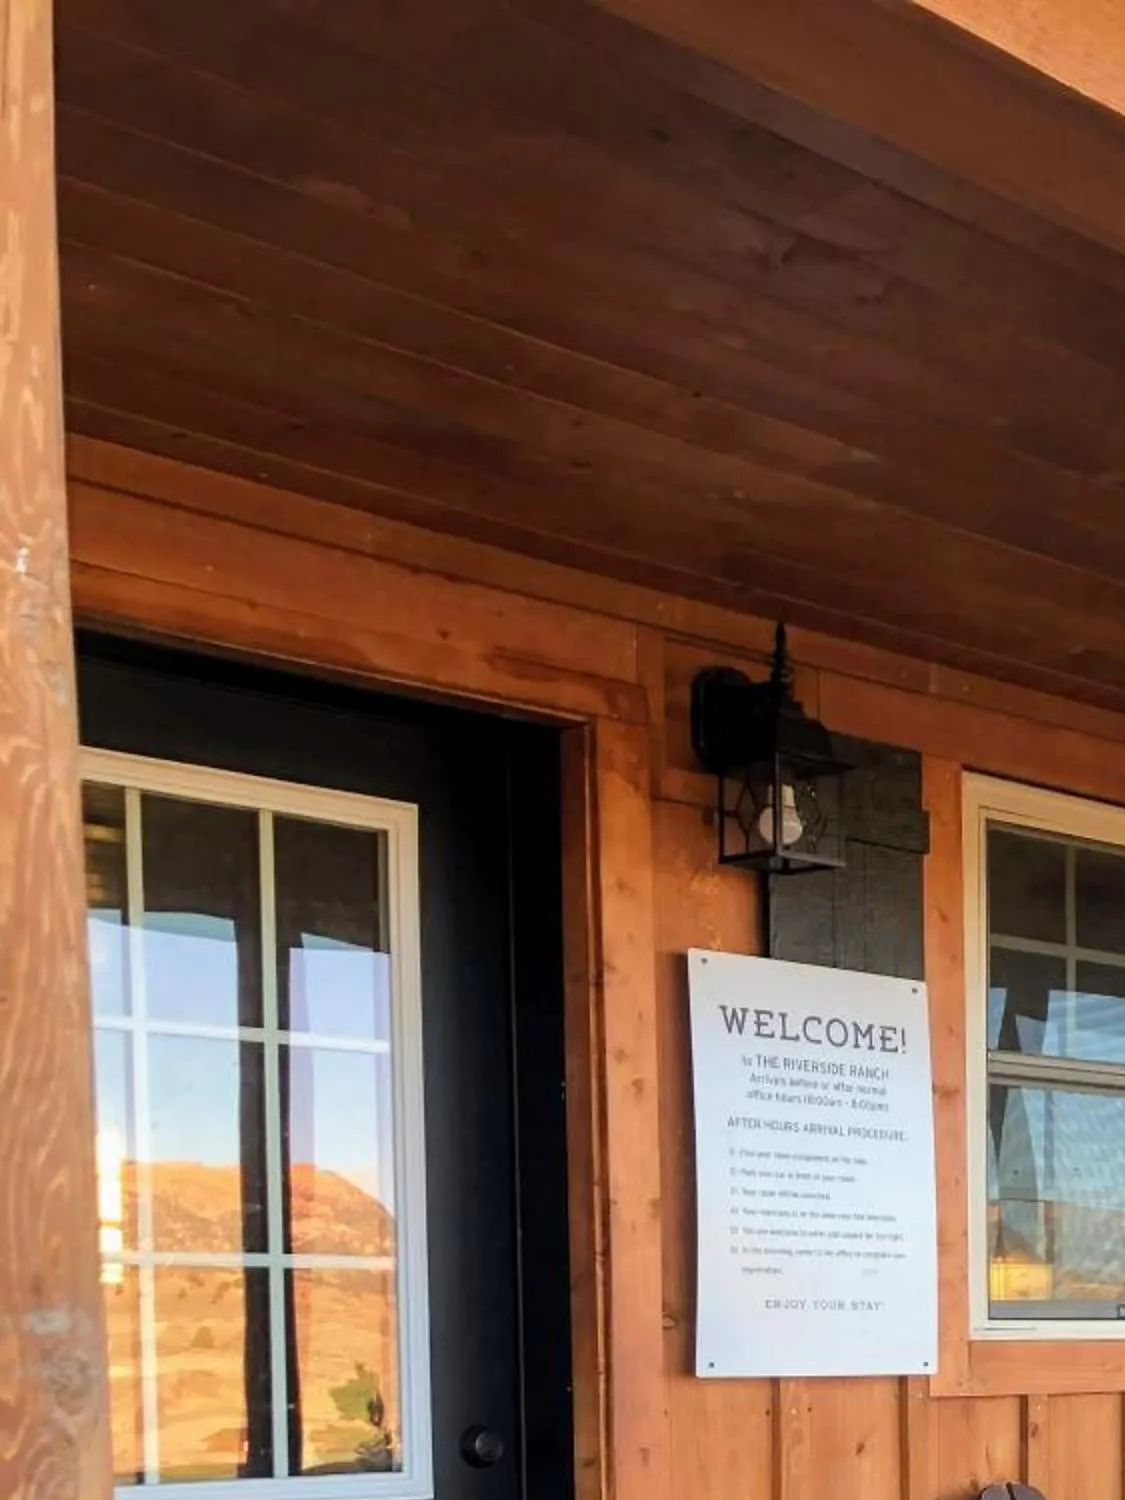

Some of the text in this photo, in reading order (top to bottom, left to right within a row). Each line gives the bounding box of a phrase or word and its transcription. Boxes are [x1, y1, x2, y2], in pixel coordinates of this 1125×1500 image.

[718, 1005, 907, 1054] WELCOME!
[755, 1054, 780, 1069] THE
[783, 1058, 846, 1076] RIVERSIDE
[849, 1064, 889, 1081] RANCH
[727, 1116, 761, 1130] AFTER
[764, 1119, 799, 1133] HOURS
[803, 1122, 844, 1137] ARRIVAL
[764, 1299, 807, 1311] ENJOY
[812, 1299, 845, 1311] YOUR
